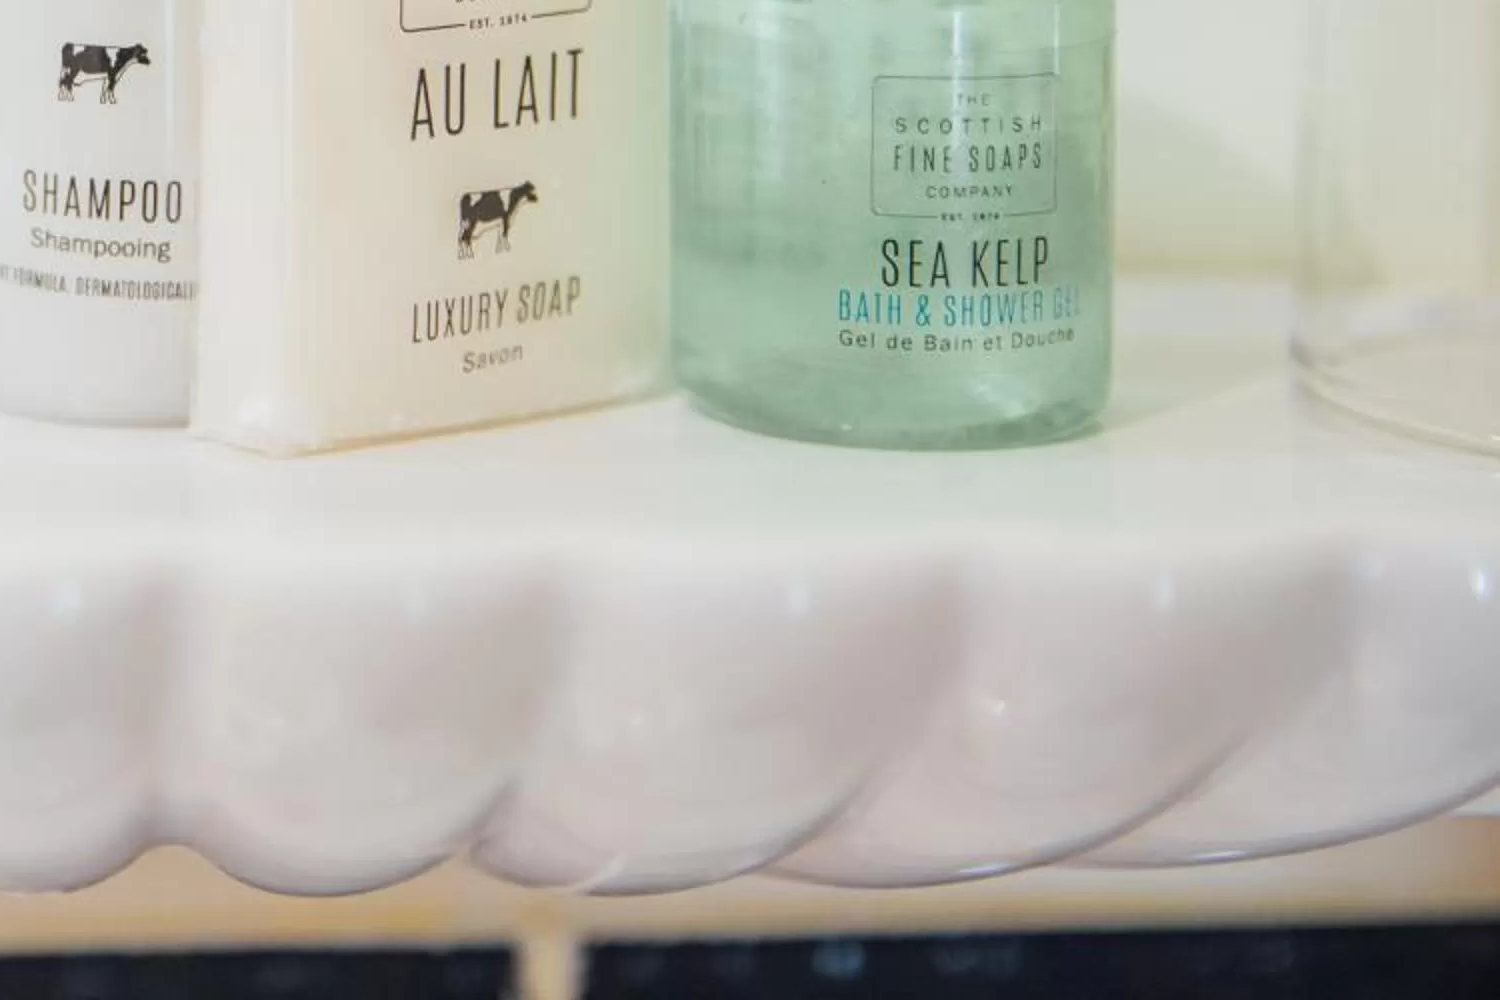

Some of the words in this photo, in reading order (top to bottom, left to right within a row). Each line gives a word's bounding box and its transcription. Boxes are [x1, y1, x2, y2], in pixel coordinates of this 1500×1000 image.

[410, 63, 467, 141] AU
[493, 48, 584, 129] LAIT
[956, 93, 991, 107] THE
[894, 112, 1042, 135] SCOTTISH
[892, 144, 953, 173] FINE
[968, 142, 1042, 173] SOAPS
[22, 168, 183, 225] SHAMPOO
[925, 184, 1014, 200] COMPANY
[30, 226, 172, 265] Shampooing
[880, 238, 950, 288] SEA
[971, 235, 1050, 288] KELP
[411, 288, 507, 344] LUXURY
[516, 275, 582, 325] SOAP
[838, 288, 902, 325] BATH
[914, 294, 932, 327] &
[943, 290, 1044, 327] SHOWER
[838, 329, 876, 349] Gel
[885, 331, 913, 351] de
[923, 334, 973, 353] Bain
[982, 334, 1001, 352] et
[1011, 328, 1076, 350] Douche
[461, 343, 524, 374] Savon
